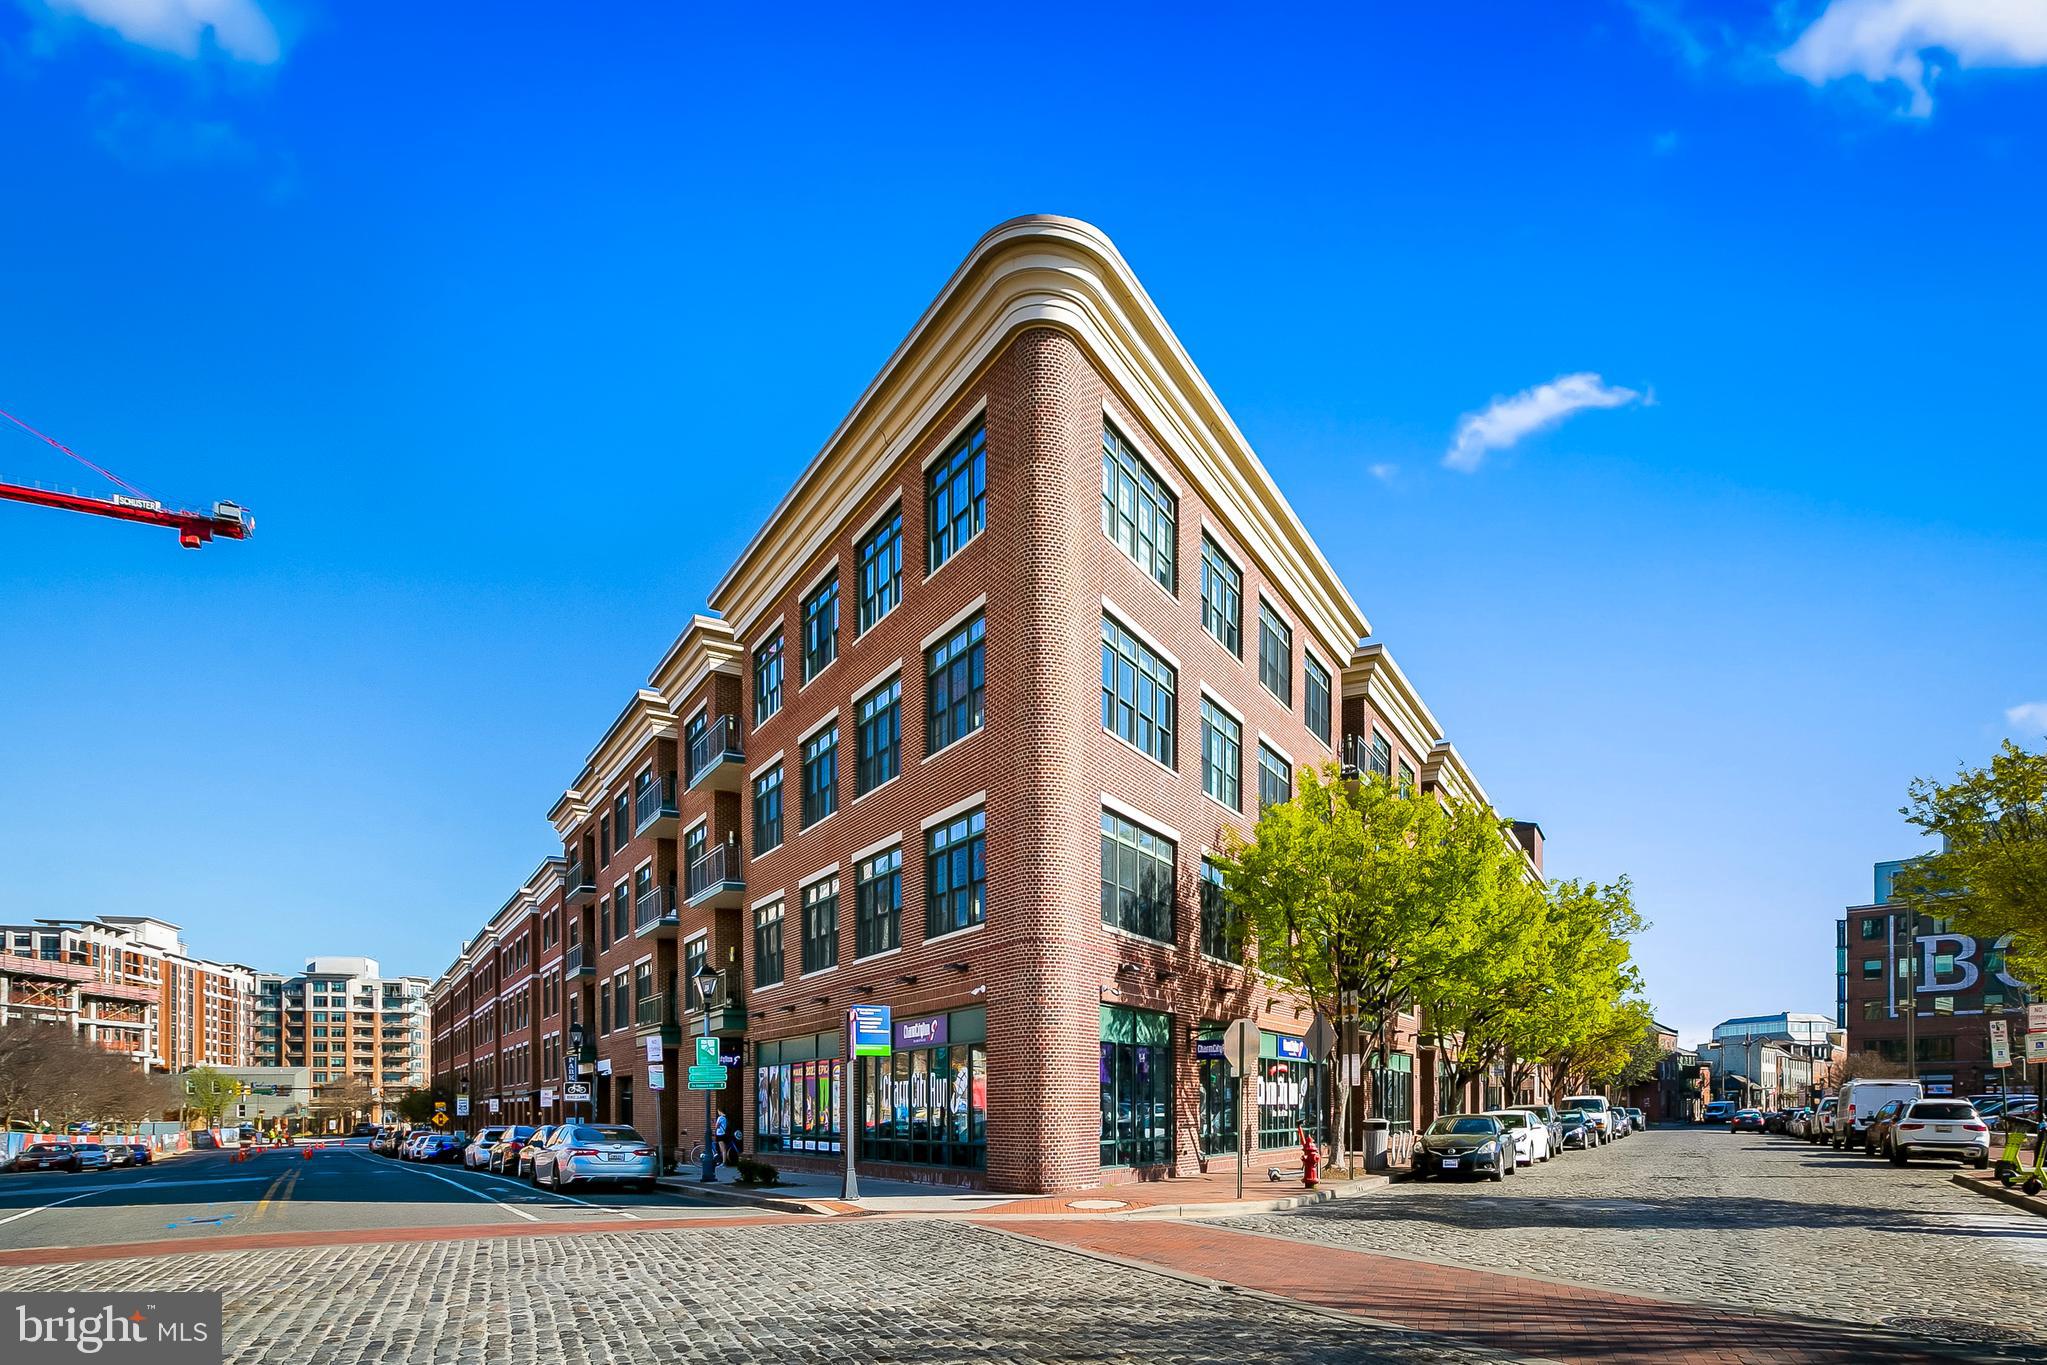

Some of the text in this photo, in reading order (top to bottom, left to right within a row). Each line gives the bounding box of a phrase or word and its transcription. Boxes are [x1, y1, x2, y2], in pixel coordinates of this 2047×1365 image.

[119, 495, 158, 510] SCHUSTER
[568, 1056, 576, 1082] PARK
[930, 1072, 948, 1108] Run
